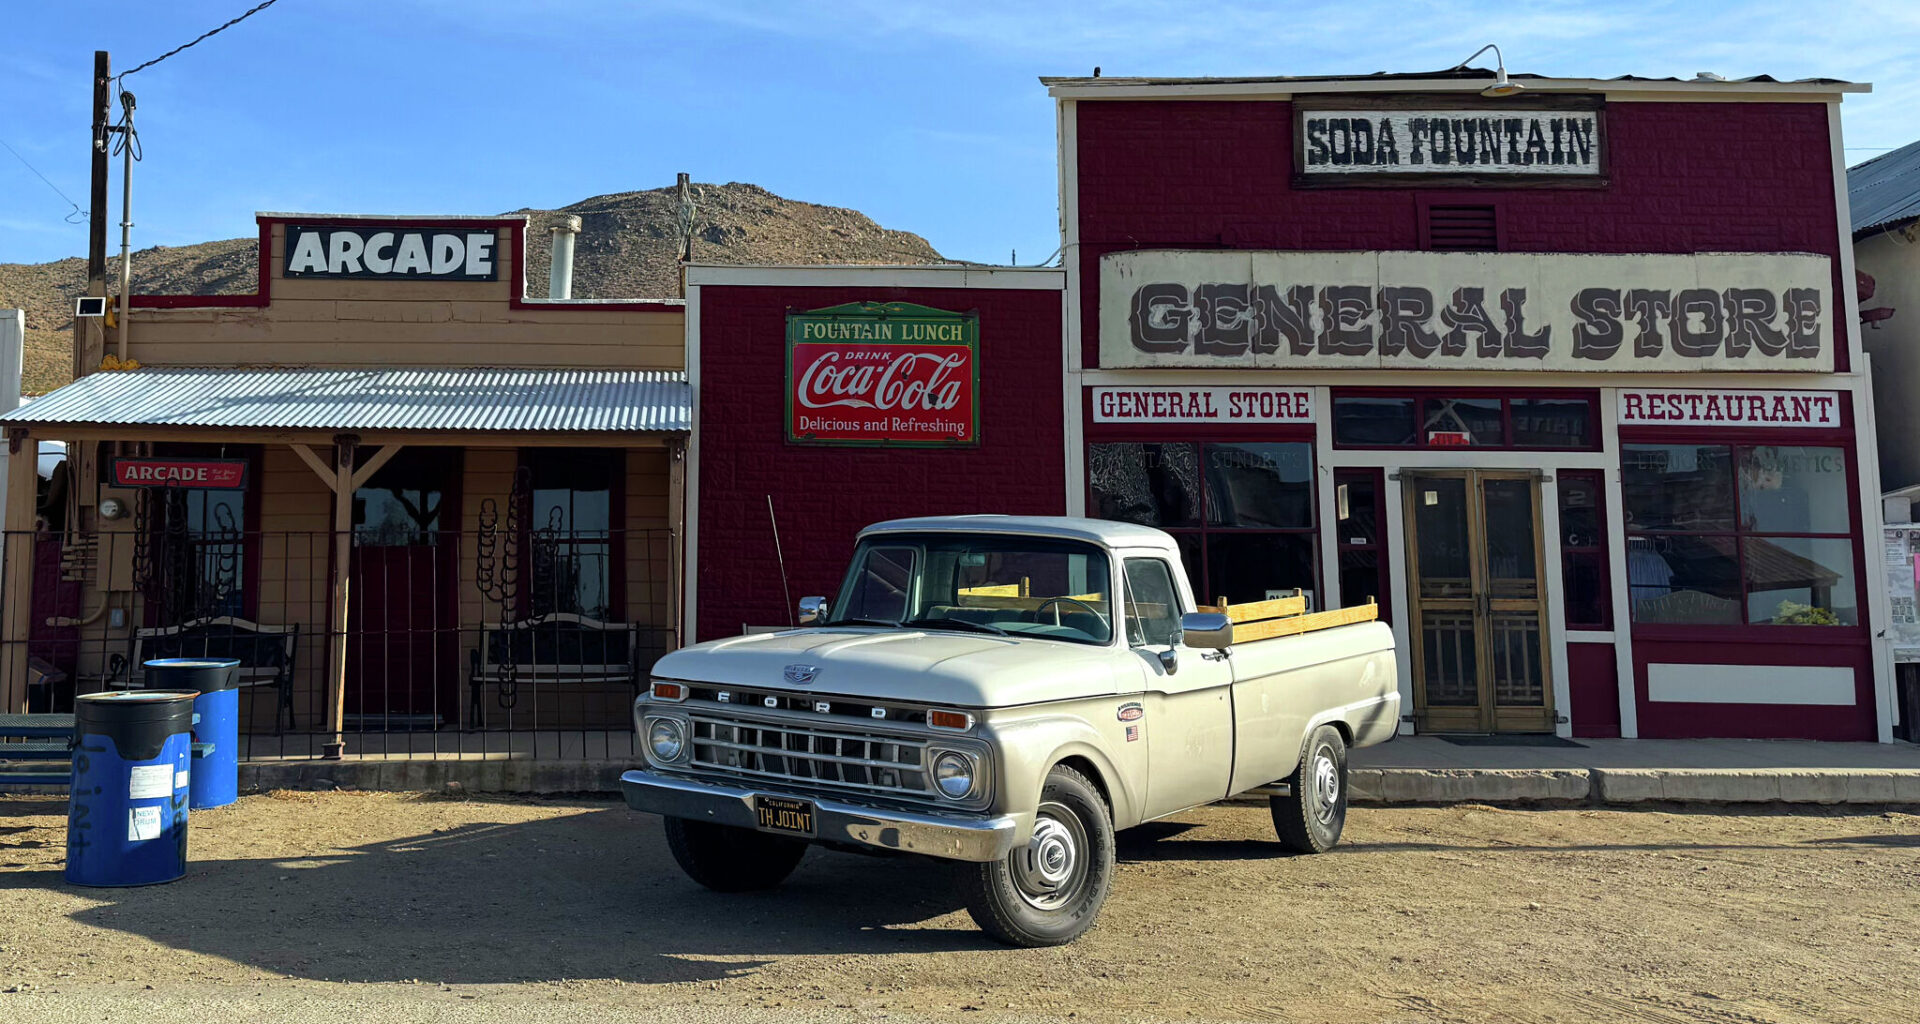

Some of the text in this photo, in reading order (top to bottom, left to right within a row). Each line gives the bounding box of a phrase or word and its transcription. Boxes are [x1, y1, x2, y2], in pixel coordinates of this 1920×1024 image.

[1307, 118, 1593, 165] SODA FOUNTAIN
[288, 231, 495, 275] ARCADE
[803, 323, 963, 341] FOUNTAIN LUNCH
[1128, 283, 1821, 360] GENERAL STORE
[845, 351, 892, 360] DRINK
[798, 352, 966, 410] Coca-Cola
[1100, 391, 1309, 418] GENERAL STORE
[1624, 393, 1832, 422] RESTAURANT
[800, 415, 965, 436] Delicious and Refreshing
[125, 466, 208, 480] ARCADE
[1739, 455, 1843, 473] CSMETICS
[718, 691, 886, 719] FORD
[769, 801, 800, 809] CALIFORNIA
[759, 808, 811, 831] TH JOINT
